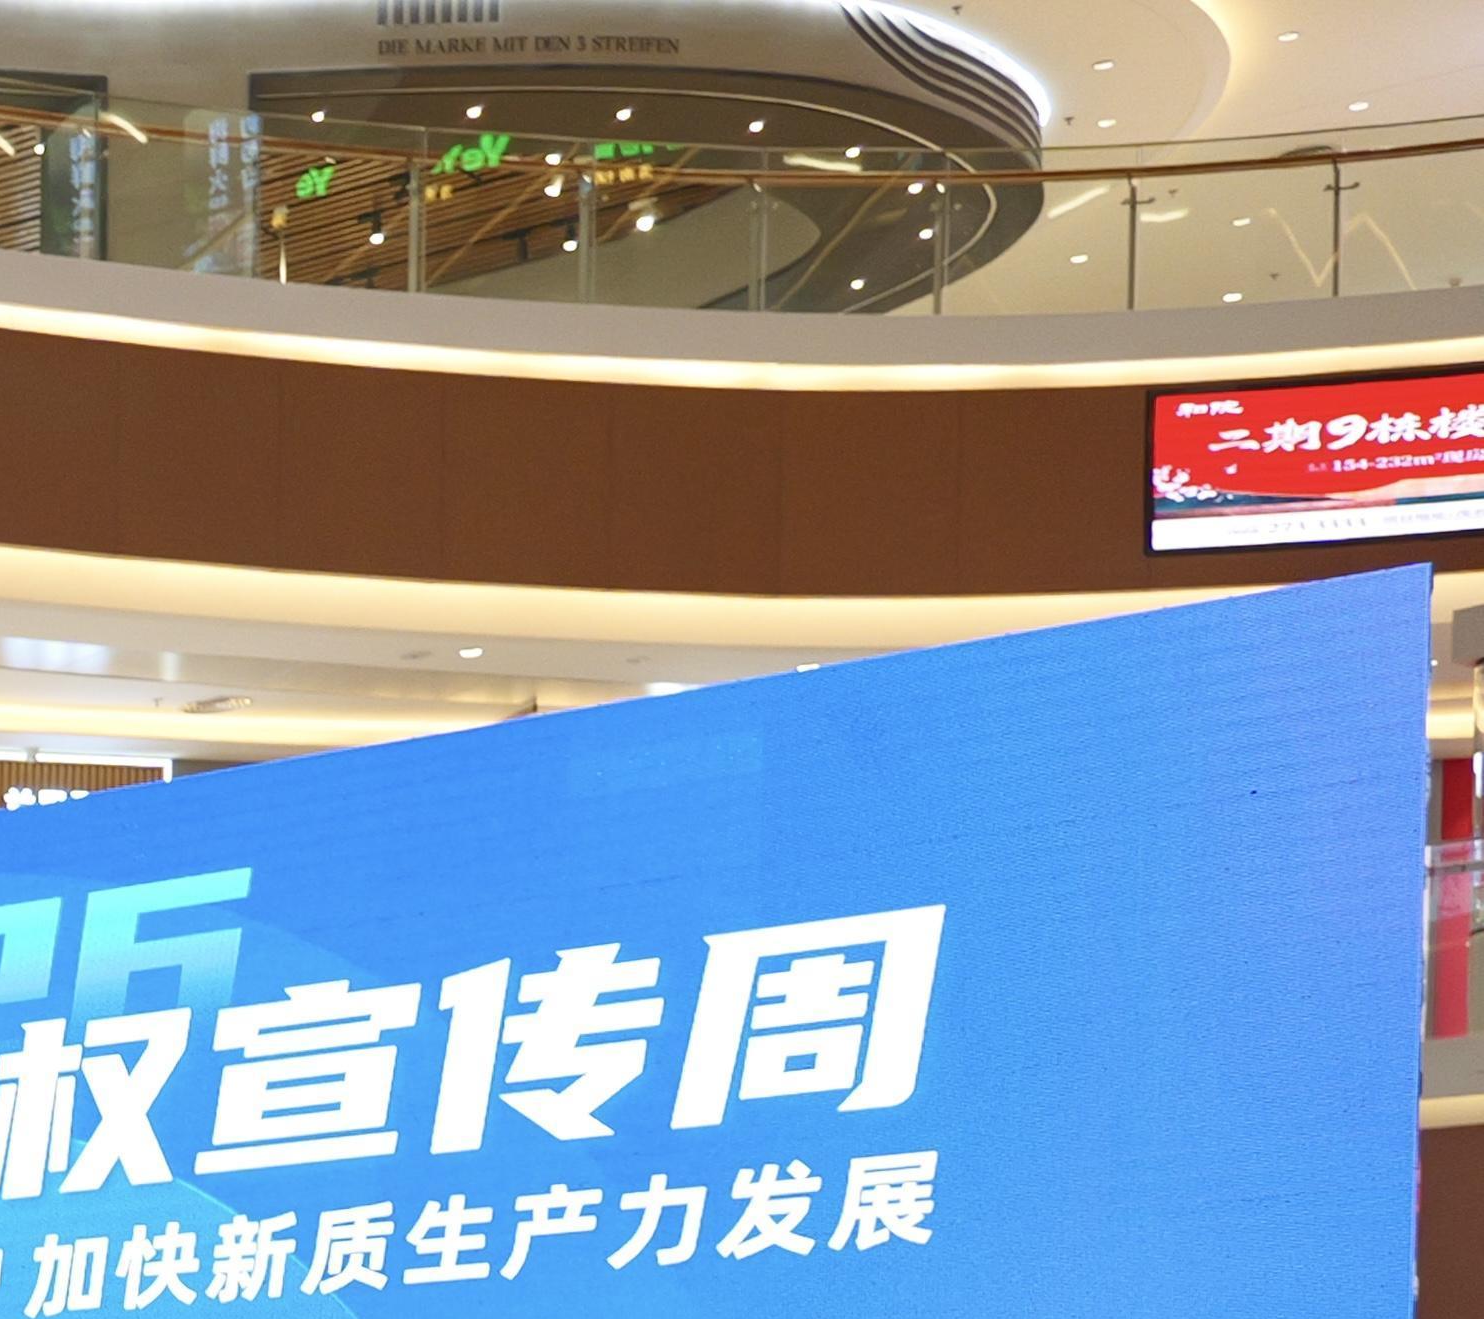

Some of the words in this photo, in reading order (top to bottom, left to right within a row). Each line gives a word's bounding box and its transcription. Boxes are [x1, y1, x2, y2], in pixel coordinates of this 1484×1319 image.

[492, 37, 528, 53] MIT
[535, 36, 571, 52] DEN
[24, 1150, 939, 1318] 加快新质生产力发展
